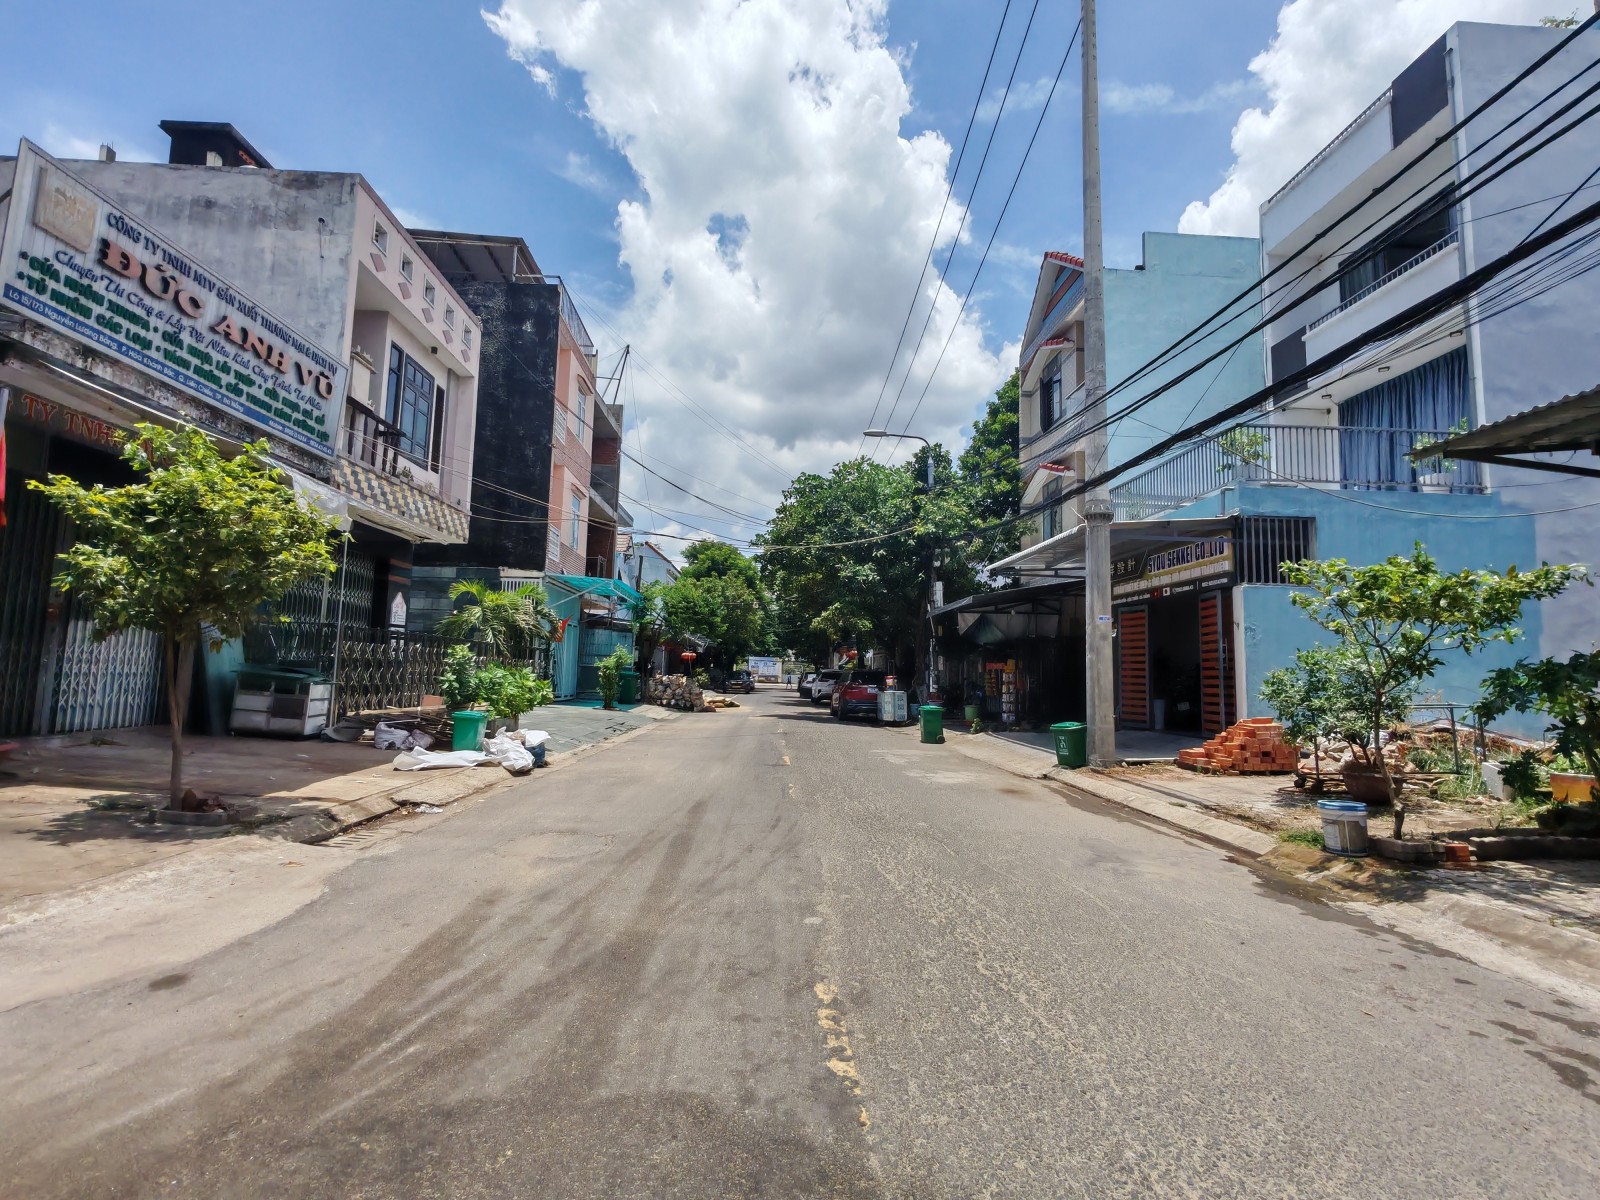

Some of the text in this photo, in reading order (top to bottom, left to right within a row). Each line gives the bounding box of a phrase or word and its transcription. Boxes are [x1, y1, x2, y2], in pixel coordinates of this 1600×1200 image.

[55, 250, 98, 285] Chuyên
[99, 274, 125, 298] Thi
[127, 292, 154, 318] Công
[107, 213, 142, 244] CÔNG
[144, 235, 160, 256] TY
[162, 248, 191, 278] TNHH
[192, 270, 216, 292] MTV
[216, 286, 236, 307] SẢN
[21, 295, 44, 312] 15/173
[26, 274, 48, 296] TỦ
[95, 313, 123, 335] CÁC
[124, 328, 153, 351] LOẠI
[28, 256, 61, 284] CỬA
[161, 330, 184, 351] CỬA
[98, 239, 333, 399] ĐỨC ANH VŨ
[22, 394, 58, 424] TY
[1167, 544, 1194, 570] SEKKEI
